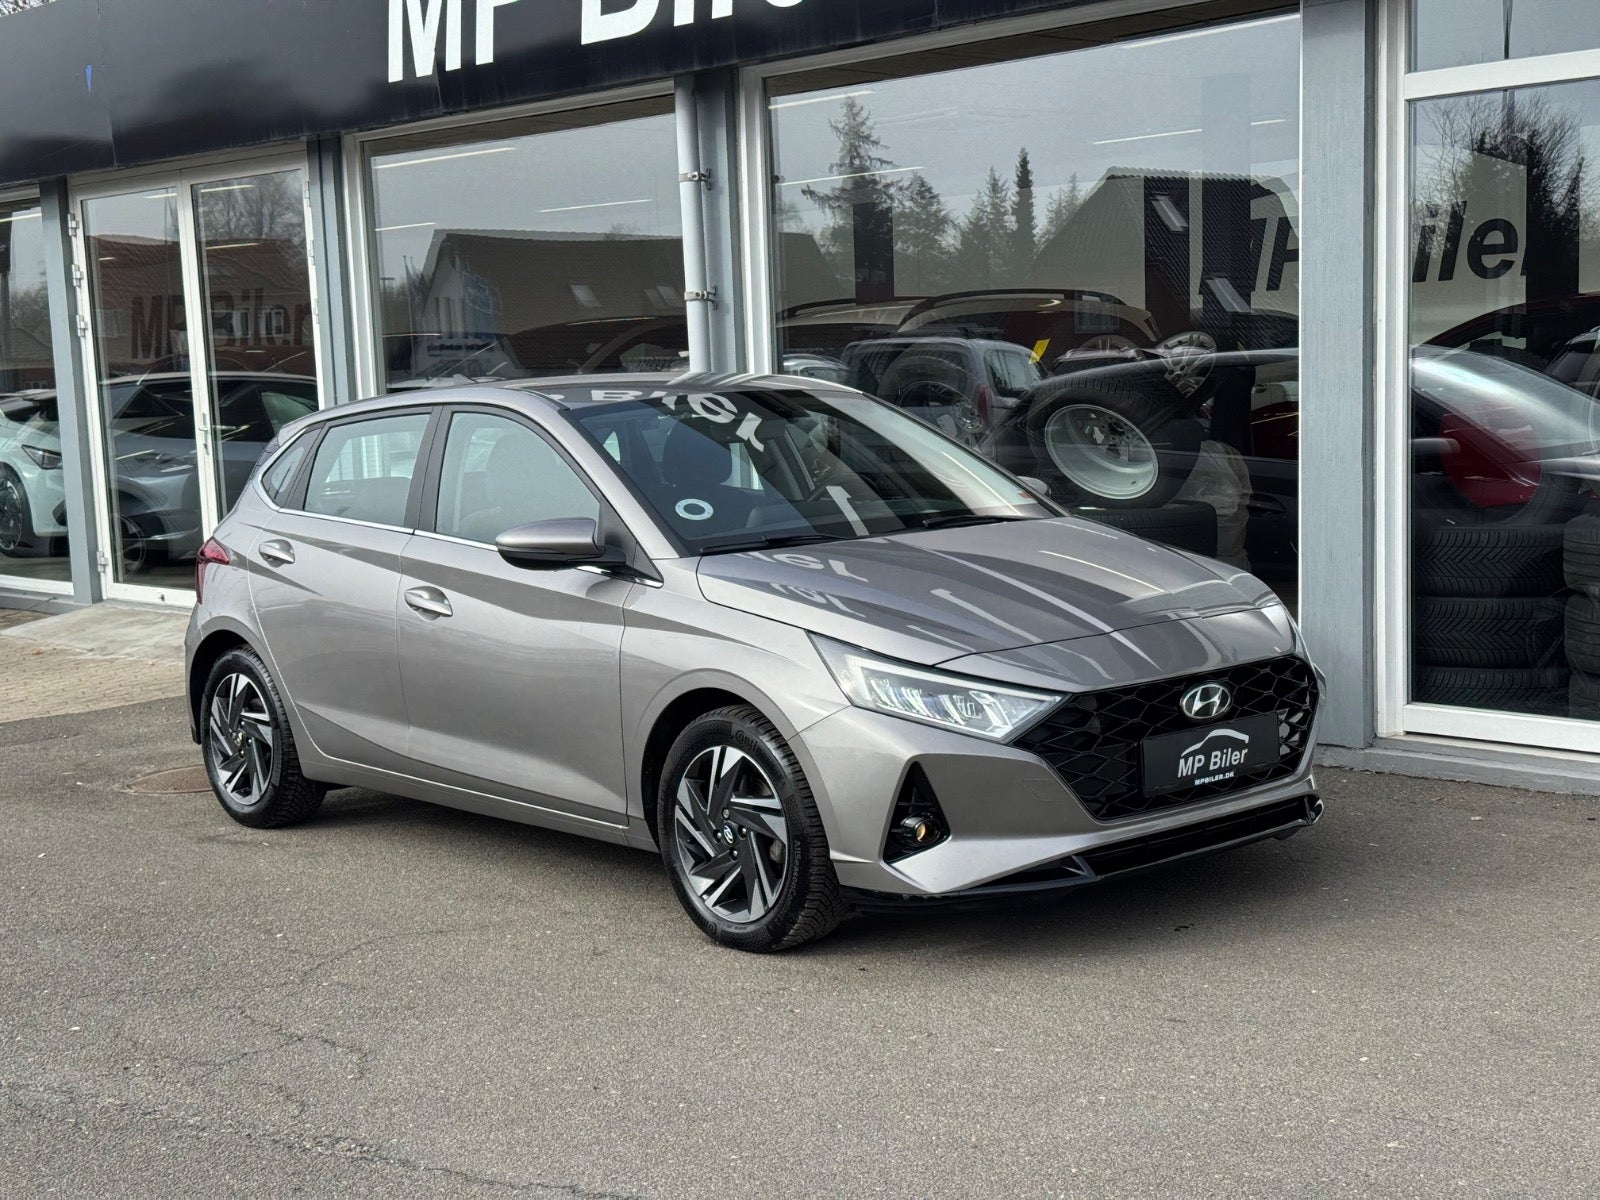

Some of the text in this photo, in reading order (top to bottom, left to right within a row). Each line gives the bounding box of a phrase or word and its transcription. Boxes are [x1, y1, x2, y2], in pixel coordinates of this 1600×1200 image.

[1178, 748, 1248, 777] MP Biler
[1194, 771, 1235, 786] MPBILER.DK
